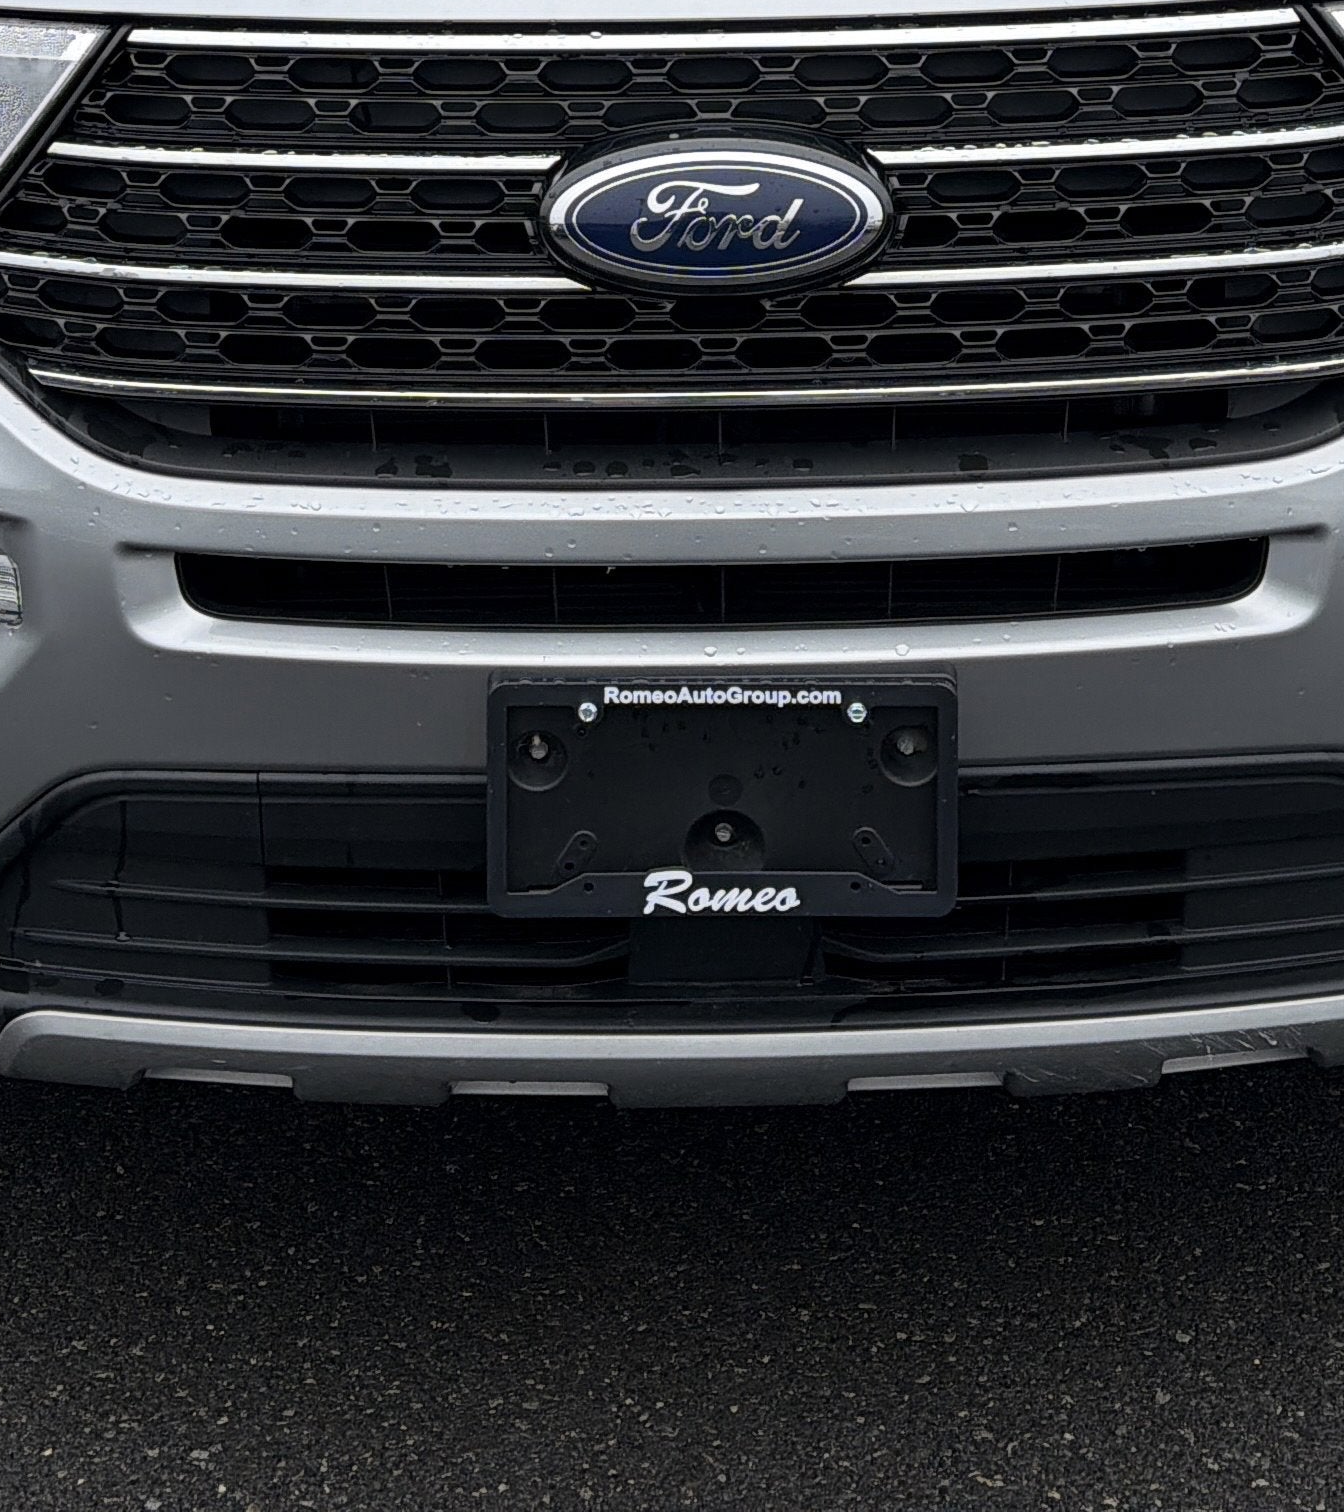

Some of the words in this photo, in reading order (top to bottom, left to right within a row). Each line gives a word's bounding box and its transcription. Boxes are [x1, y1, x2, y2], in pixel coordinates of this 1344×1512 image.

[630, 180, 804, 252] Ford
[603, 686, 842, 708] RomeoAutoGroup.com
[642, 870, 801, 915] Romeo
